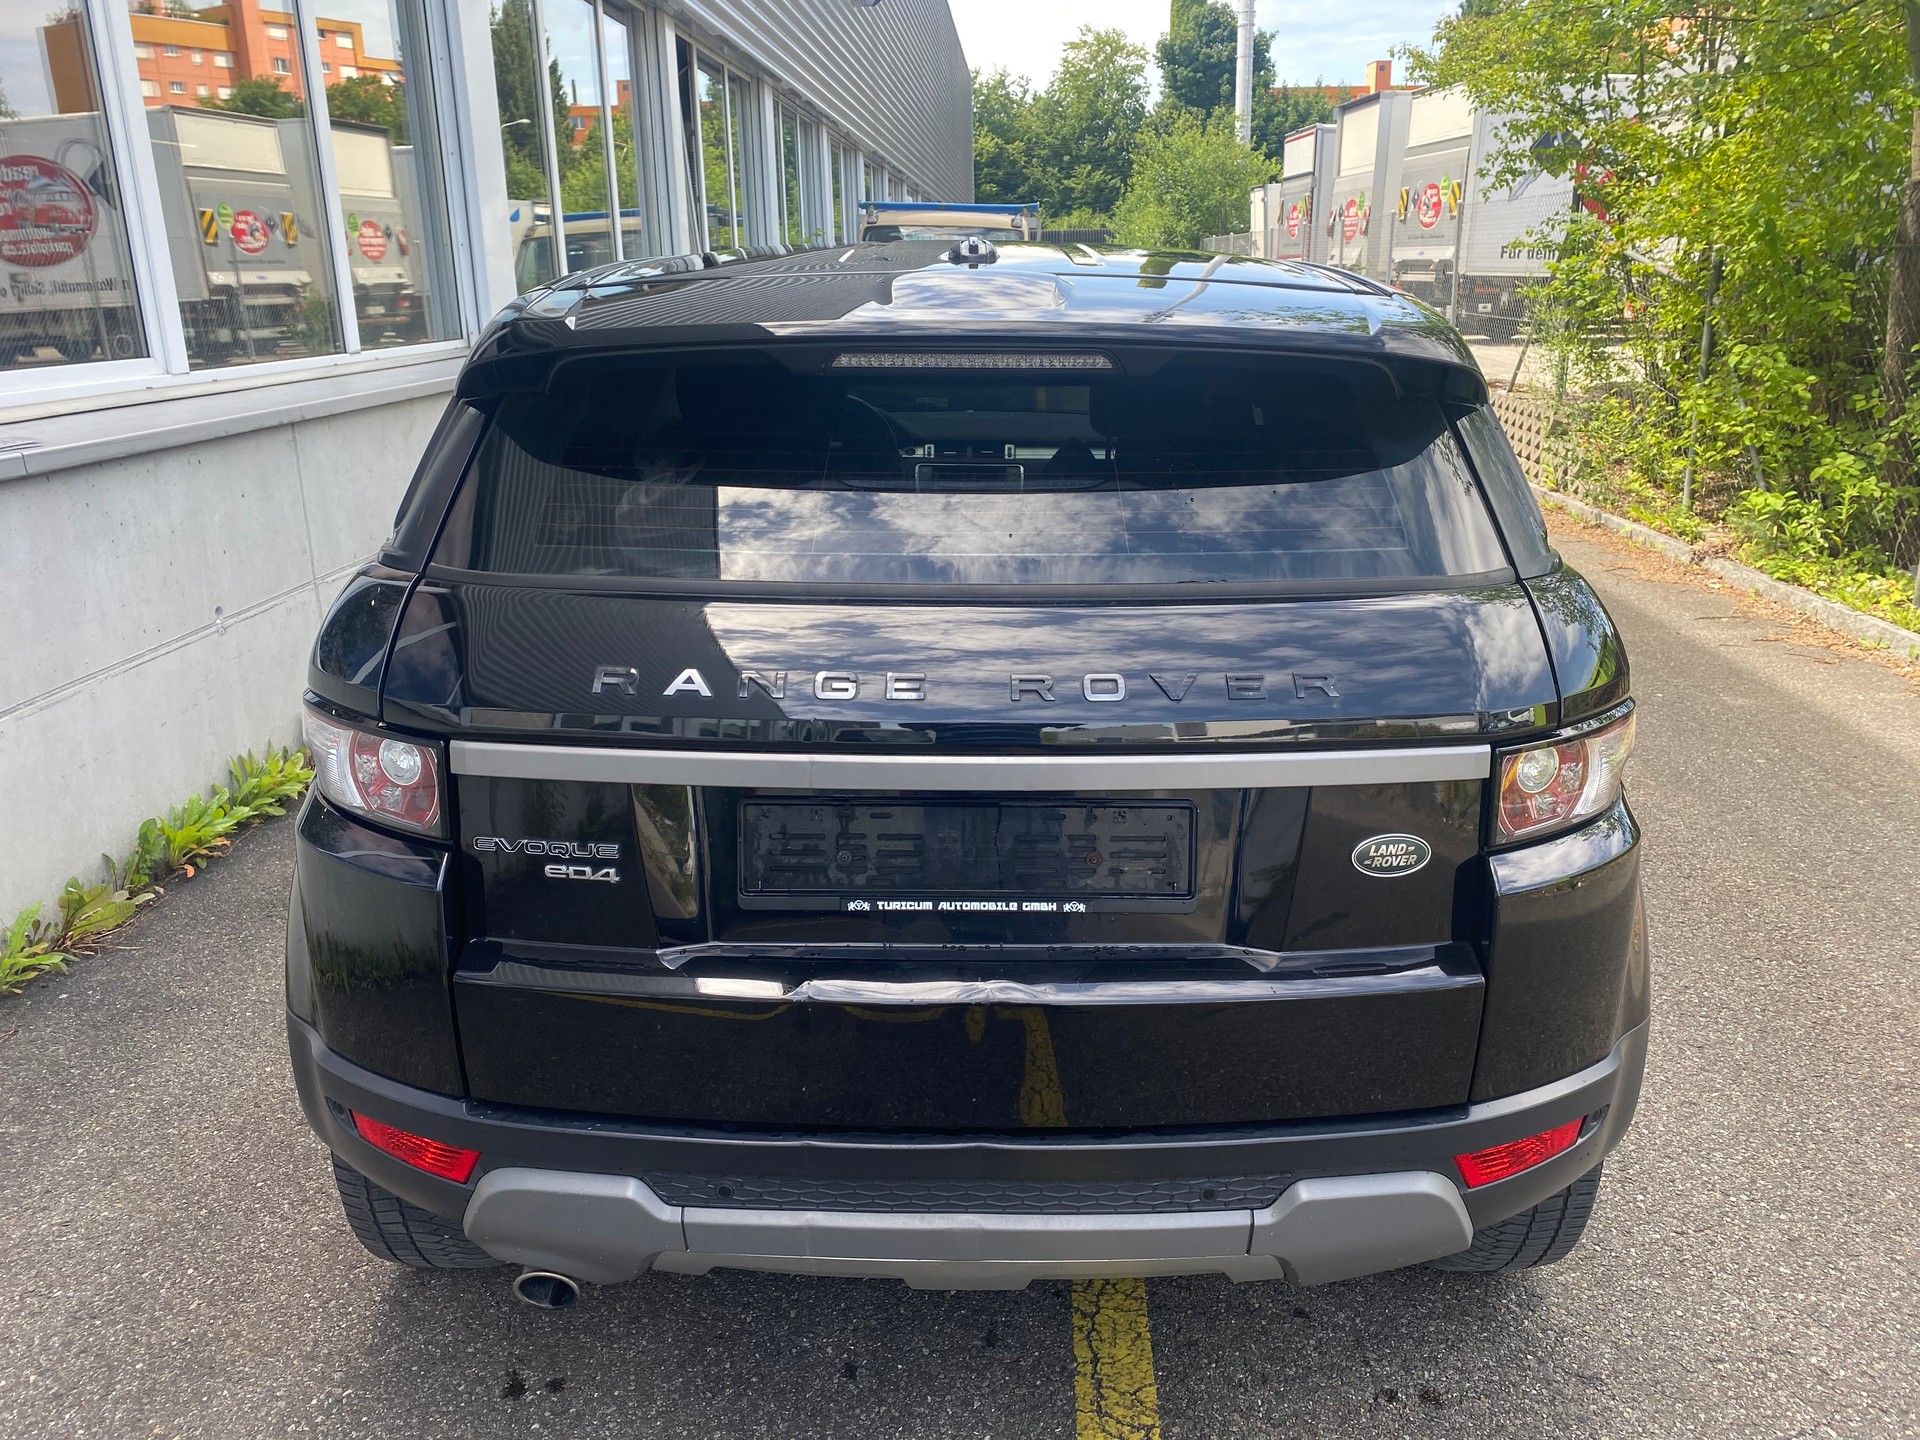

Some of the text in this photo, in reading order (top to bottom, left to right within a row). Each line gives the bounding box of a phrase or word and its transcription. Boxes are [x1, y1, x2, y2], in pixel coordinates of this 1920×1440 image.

[592, 667, 1340, 701] RANGE ROVER
[473, 836, 620, 858] EVOQUE
[1369, 843, 1407, 856] LAND
[1372, 854, 1417, 868] ROVER
[876, 901, 1057, 911] TURICUM AUTOMOBILE GMBH
